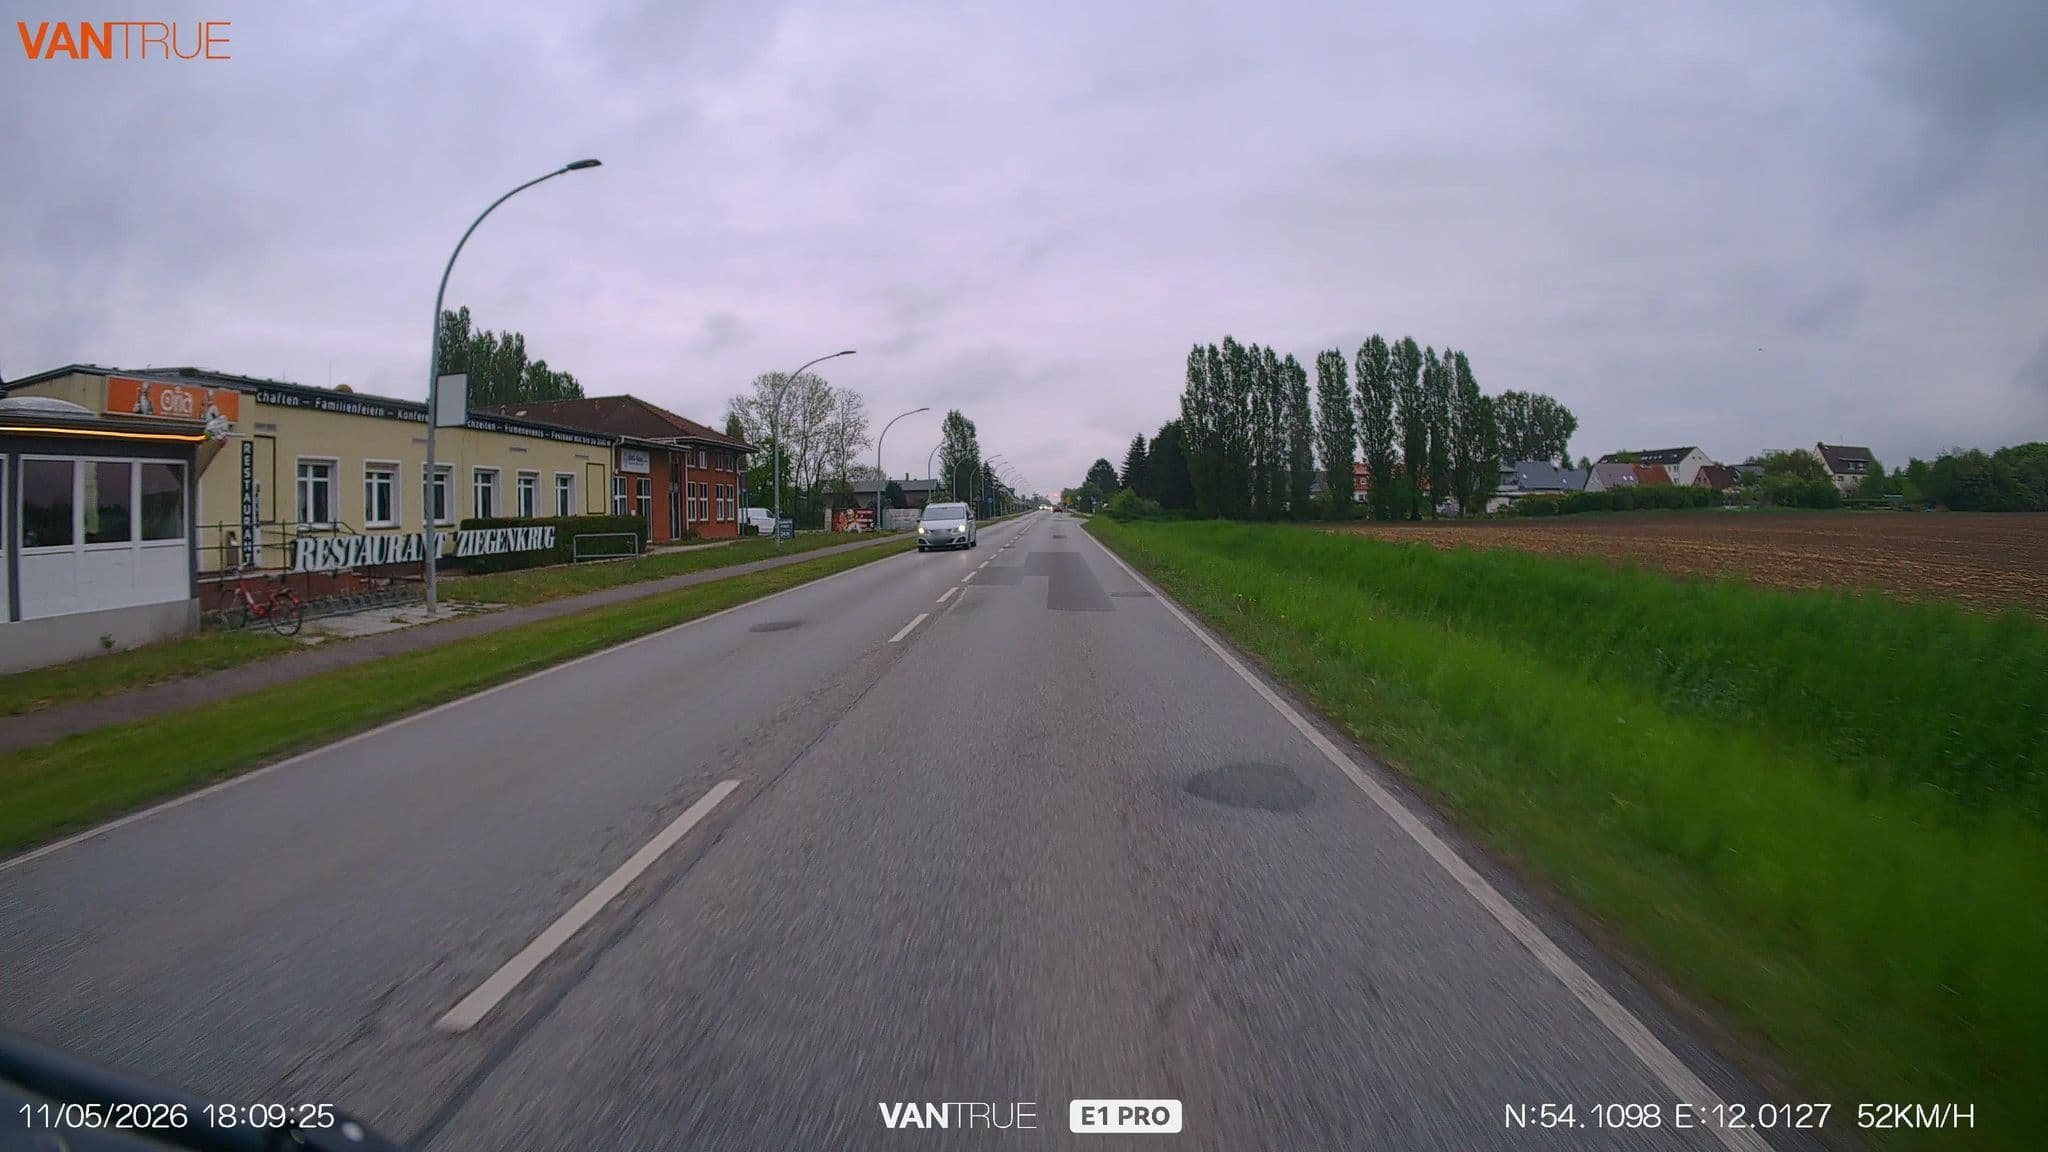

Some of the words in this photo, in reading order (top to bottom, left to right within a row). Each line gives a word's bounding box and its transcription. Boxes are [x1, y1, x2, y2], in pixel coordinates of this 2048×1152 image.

[315, 397, 384, 416] Familienfeiern
[243, 442, 252, 566] RESTAURANT
[456, 526, 555, 558] ZIEGENKRUG
